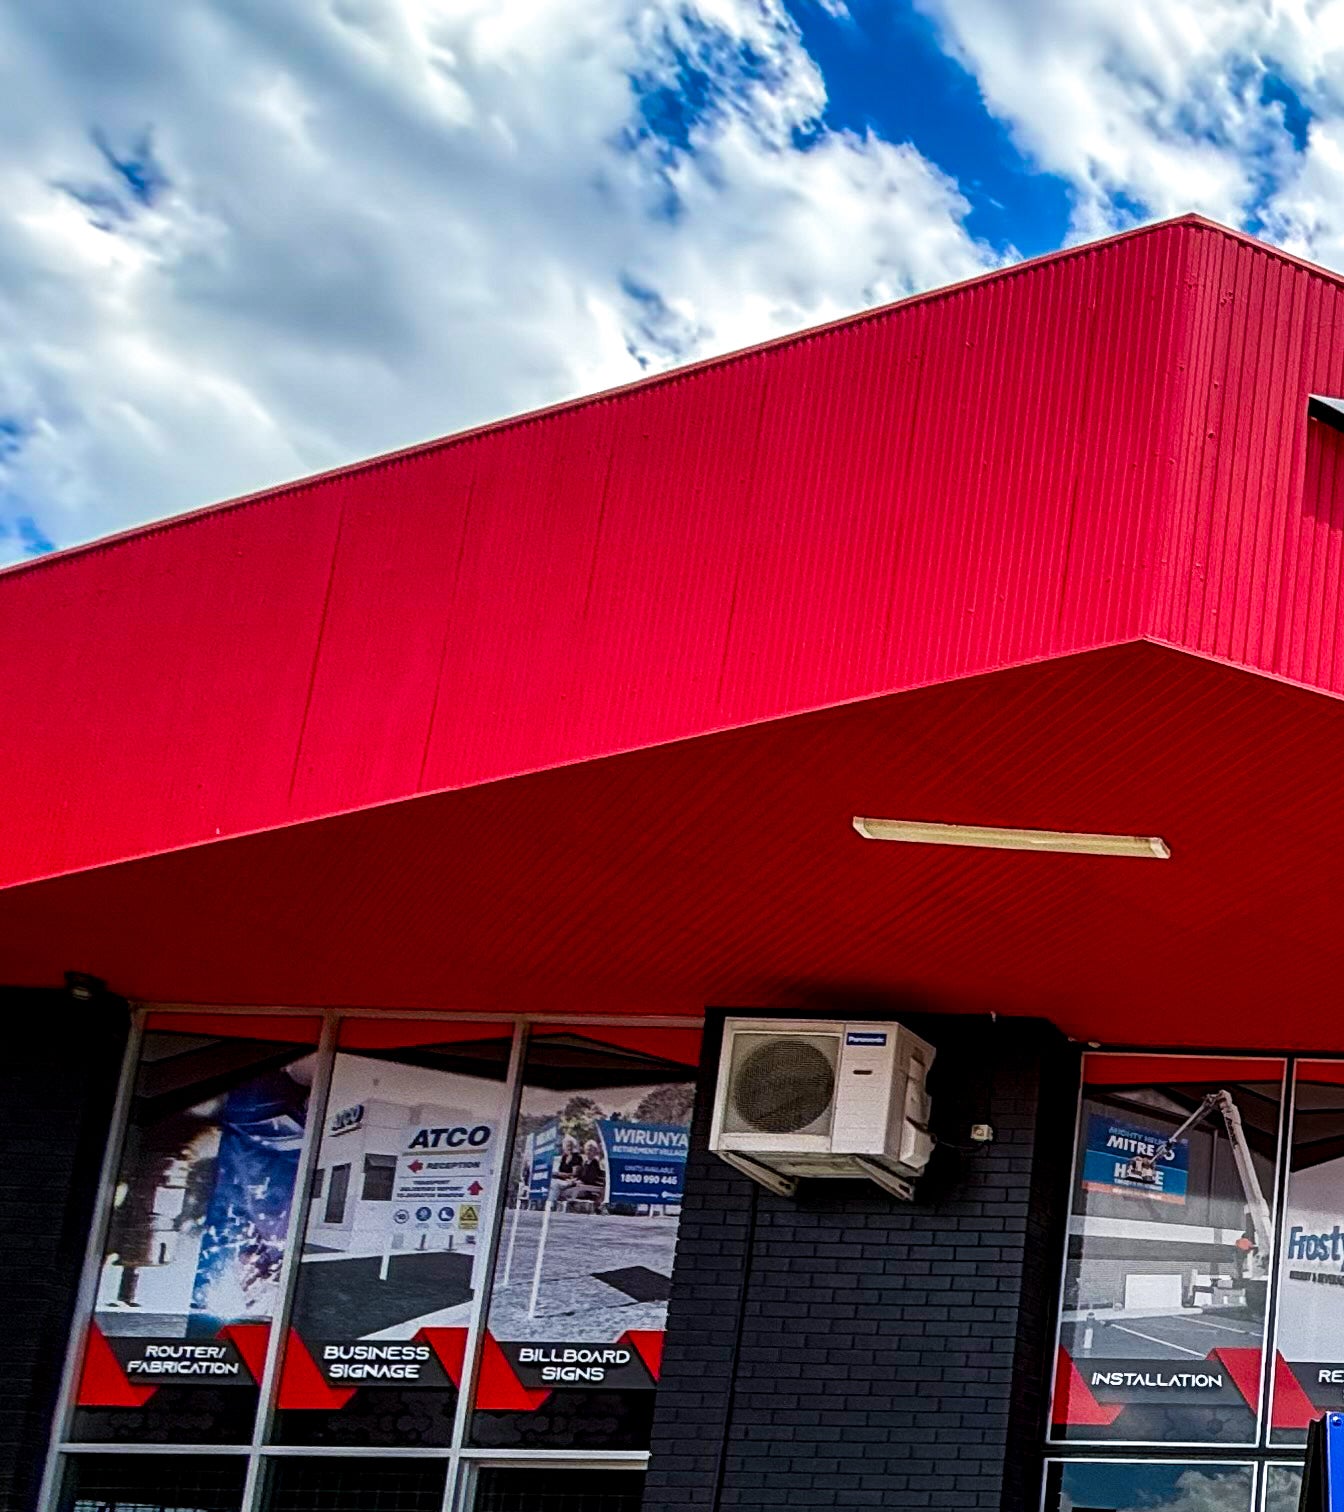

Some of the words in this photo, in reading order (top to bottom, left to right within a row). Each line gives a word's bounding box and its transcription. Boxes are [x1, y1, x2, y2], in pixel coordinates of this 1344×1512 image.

[408, 1125, 491, 1149] ATCO
[613, 1128, 688, 1147] WIRUNYA
[1107, 1136, 1155, 1157] MITRE
[1114, 1162, 1164, 1185] HE
[145, 1344, 226, 1359] ROUTER/
[323, 1345, 430, 1362] BUSINESS
[518, 1347, 630, 1365] BILLBOARD
[126, 1361, 240, 1376] FABRICATION
[329, 1363, 421, 1379] SIGNAGE
[541, 1365, 605, 1382] SIGNS
[1091, 1372, 1222, 1389] INSTALLATION
